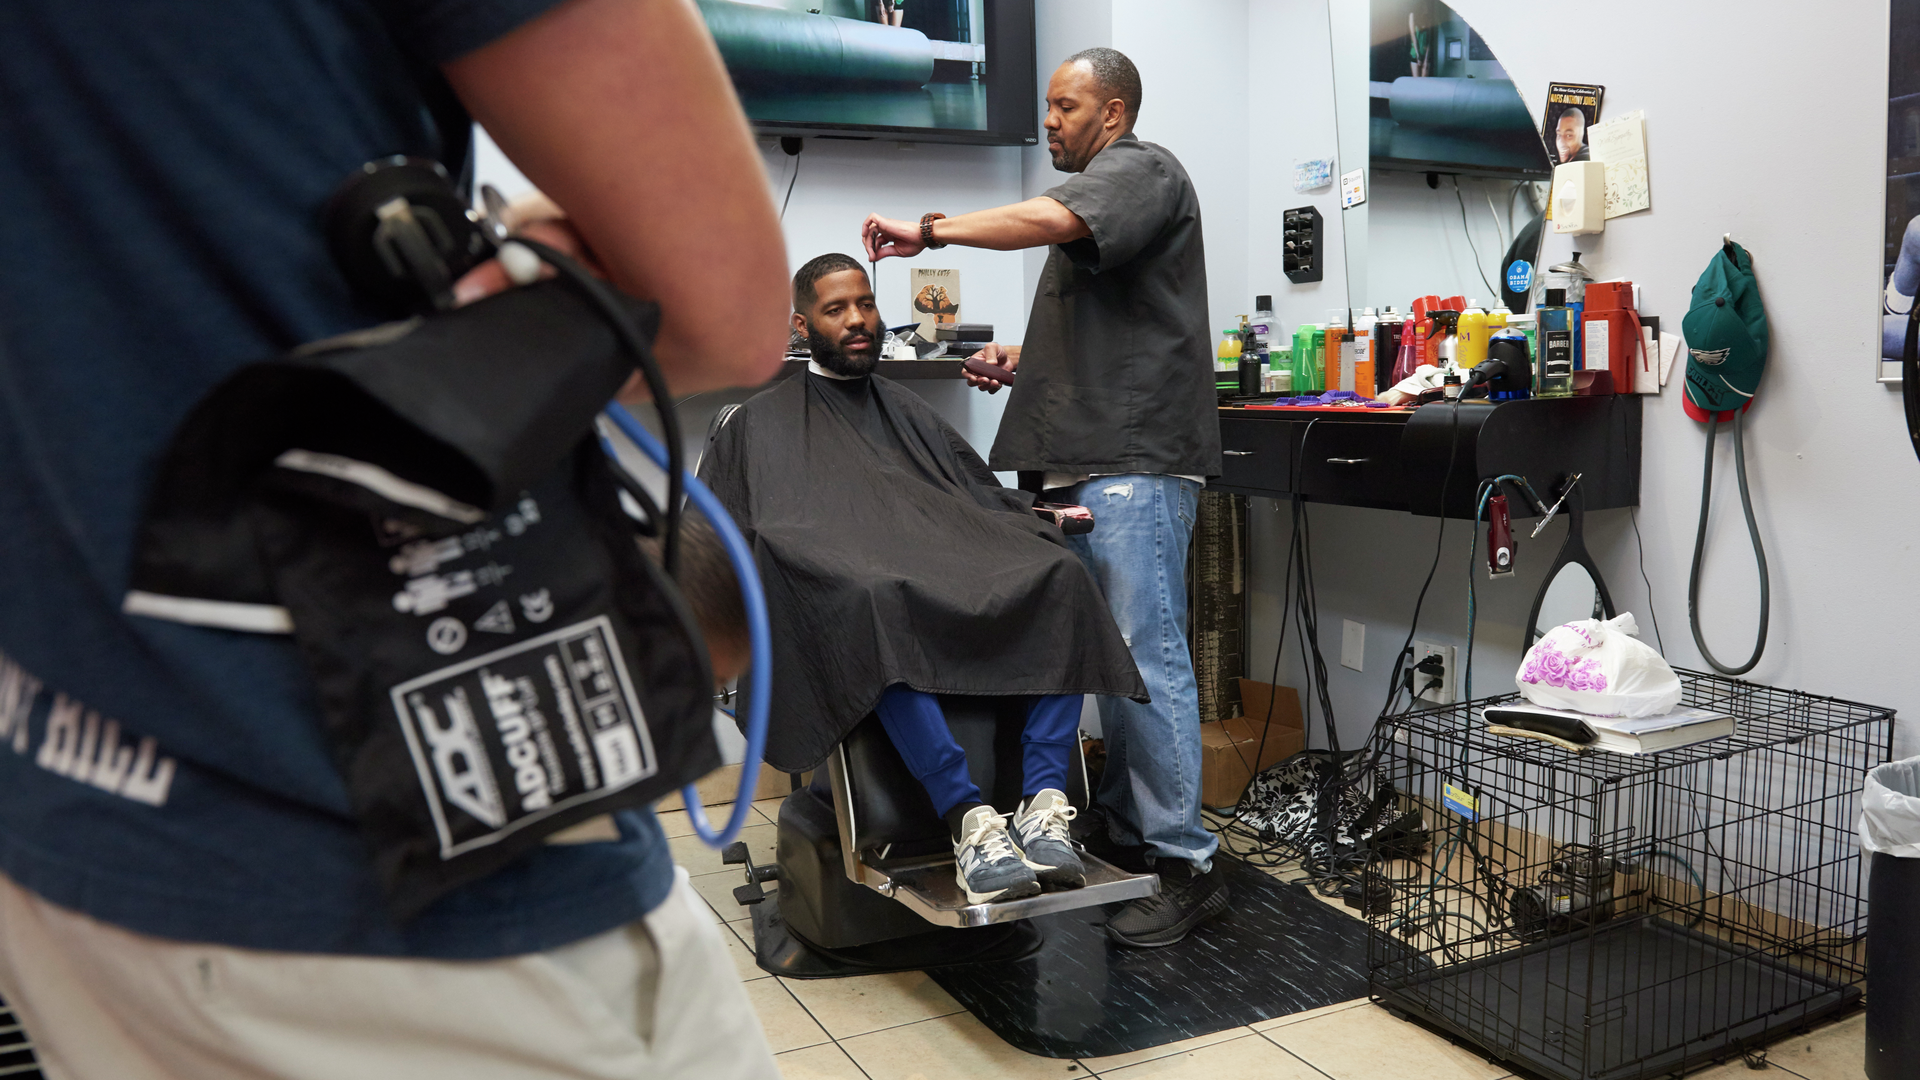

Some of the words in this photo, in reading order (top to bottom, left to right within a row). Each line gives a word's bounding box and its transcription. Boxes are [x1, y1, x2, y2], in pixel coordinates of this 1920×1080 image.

[1550, 93, 1563, 103] NAFIS
[1563, 95, 1583, 105] ANTHONY
[1583, 96, 1596, 106] JONES
[918, 269, 936, 278] PHILLY
[937, 269, 951, 278] CUTS
[1548, 340, 1569, 349] BARBER
[482, 673, 553, 812] ADCUFF
[416, 687, 507, 829] ADC
